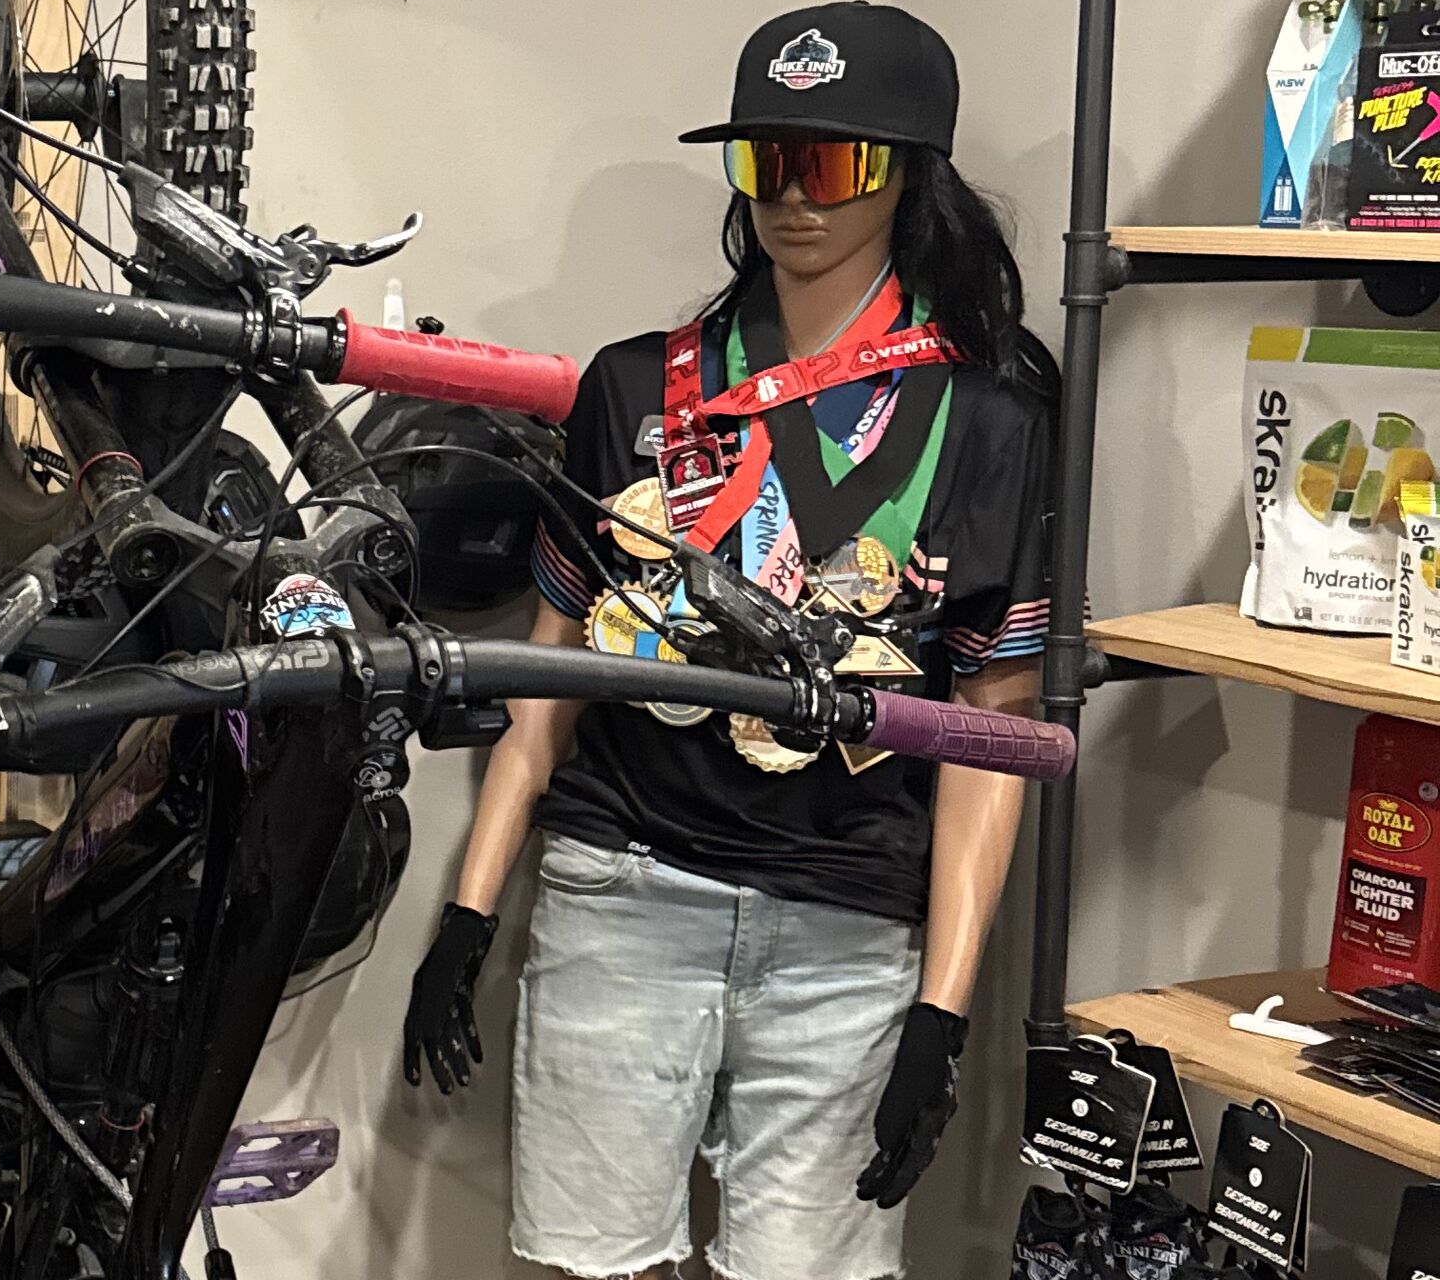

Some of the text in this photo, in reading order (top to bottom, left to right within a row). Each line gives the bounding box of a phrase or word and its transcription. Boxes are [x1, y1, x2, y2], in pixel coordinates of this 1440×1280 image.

[774, 61, 838, 73] BIKE INN
[1276, 78, 1305, 88] MSW
[1358, 86, 1428, 119] PUNCTURE
[1372, 110, 1410, 133] PLUG
[1396, 550, 1415, 653] skratch
[363, 785, 402, 804] acros
[1363, 805, 1415, 833] ROYAL
[1368, 826, 1403, 848] OAK
[1351, 867, 1415, 894] CHARCOAL
[1350, 879, 1414, 911] LIGHTER
[1355, 897, 1401, 921] FLUID
[1068, 1070, 1099, 1086] SIZE
[1044, 1117, 1117, 1148] DESIGNED IN
[1173, 1137, 1189, 1149] AR
[1102, 1157, 1124, 1170] AR
[1224, 1186, 1269, 1215] DESIGNED
